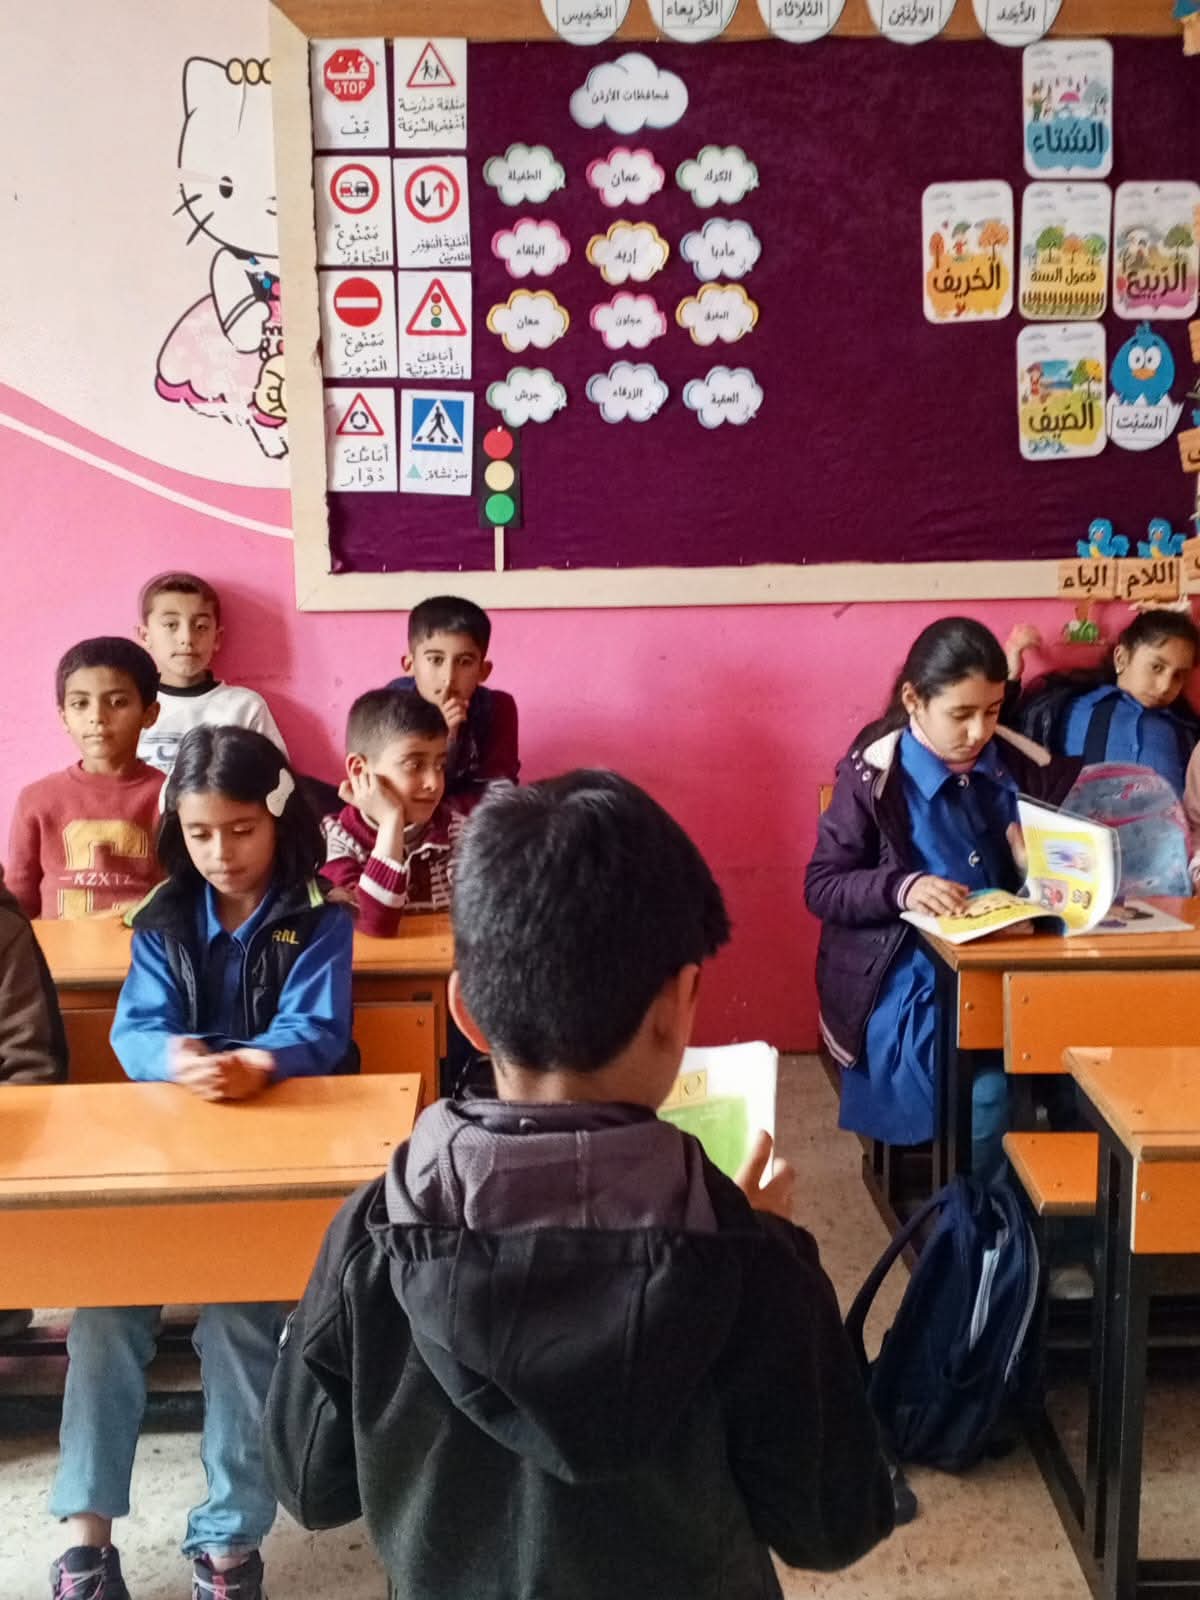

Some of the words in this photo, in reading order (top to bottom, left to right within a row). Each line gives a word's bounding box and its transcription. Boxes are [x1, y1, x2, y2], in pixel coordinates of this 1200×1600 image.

[334, 81, 367, 95] STOP
[1033, 122, 1104, 153] الشتاء
[611, 169, 640, 187] عمان
[933, 260, 1001, 299] الخريف
[1065, 268, 1097, 286] فصول
[1127, 262, 1187, 299] الربيع
[1029, 401, 1094, 438] الصيف
[1062, 565, 1107, 593] الباء
[1127, 561, 1174, 597] اللام
